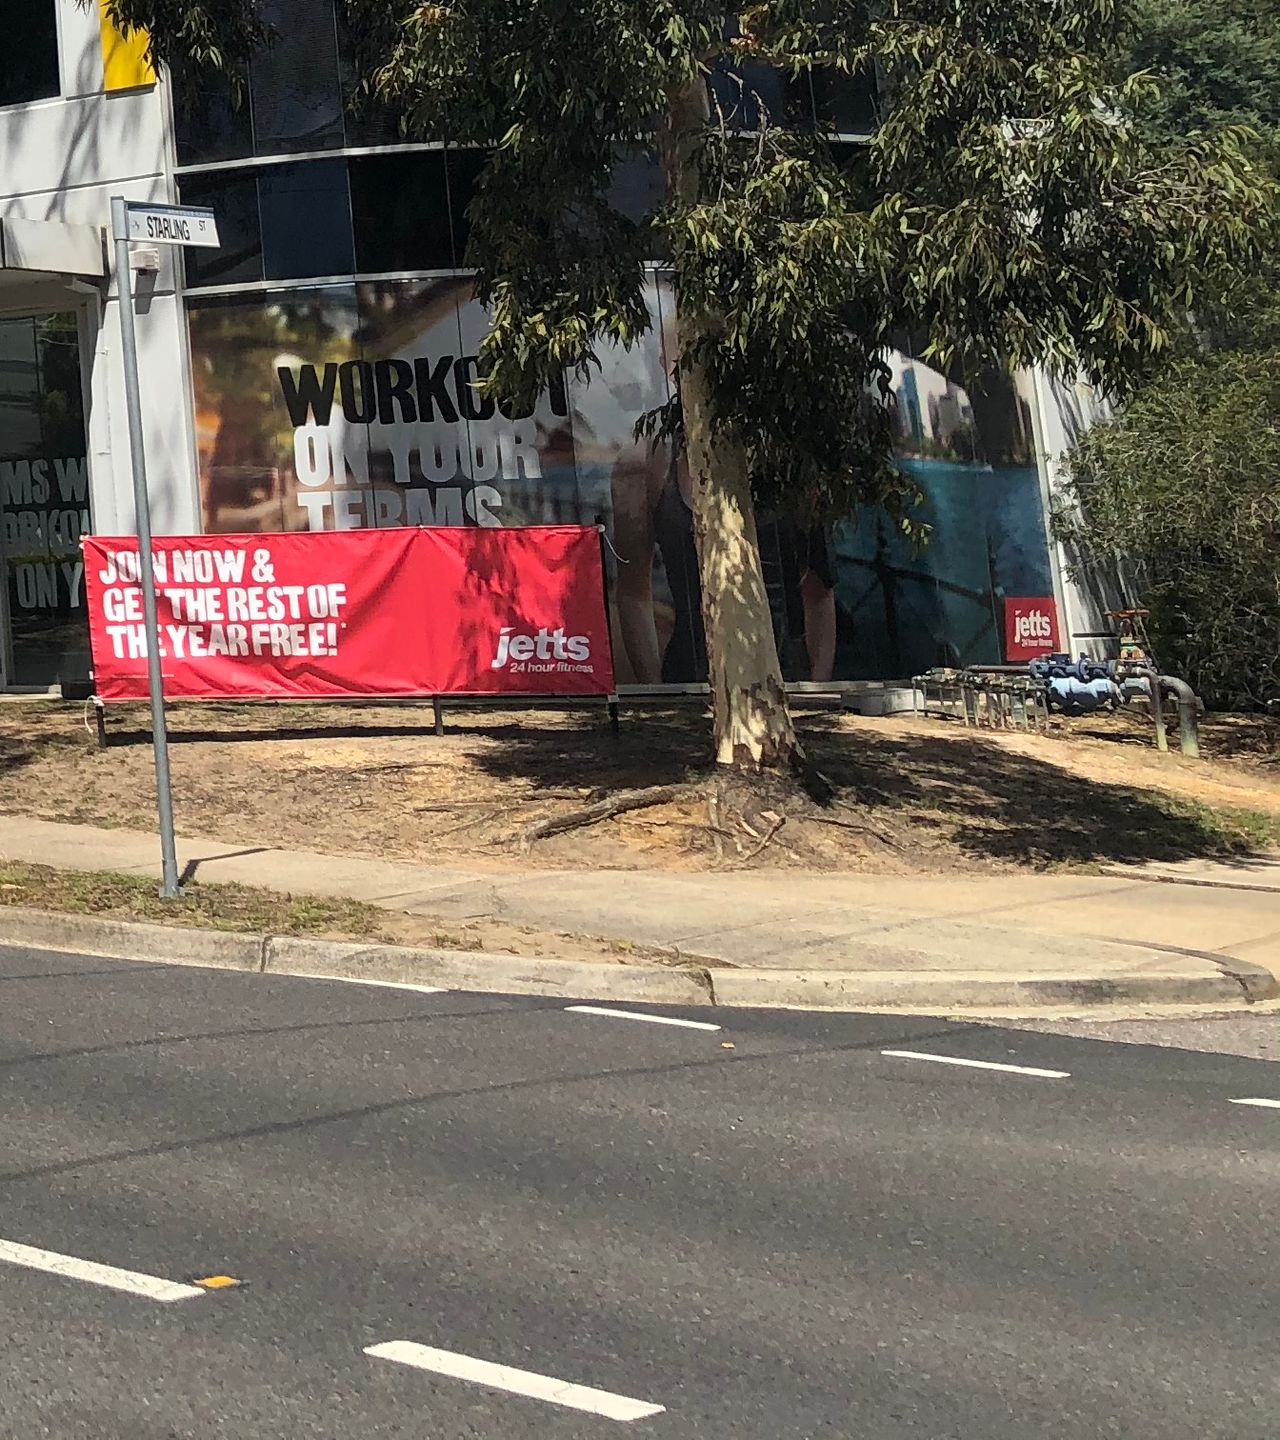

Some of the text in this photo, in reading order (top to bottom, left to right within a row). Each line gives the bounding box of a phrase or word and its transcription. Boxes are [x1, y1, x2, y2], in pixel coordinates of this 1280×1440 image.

[146, 215, 206, 240] STARLING ST
[294, 419, 543, 487] ON YOUR
[173, 548, 246, 583] NOW
[251, 548, 275, 584] &
[16, 563, 58, 609] ON
[164, 586, 224, 622] THE
[227, 585, 305, 622] REST
[306, 583, 346, 619] OF
[166, 623, 251, 659] YEAR
[1014, 610, 1051, 643] jetts
[491, 627, 590, 669] jetts
[510, 661, 594, 673] 24 hour fitness
